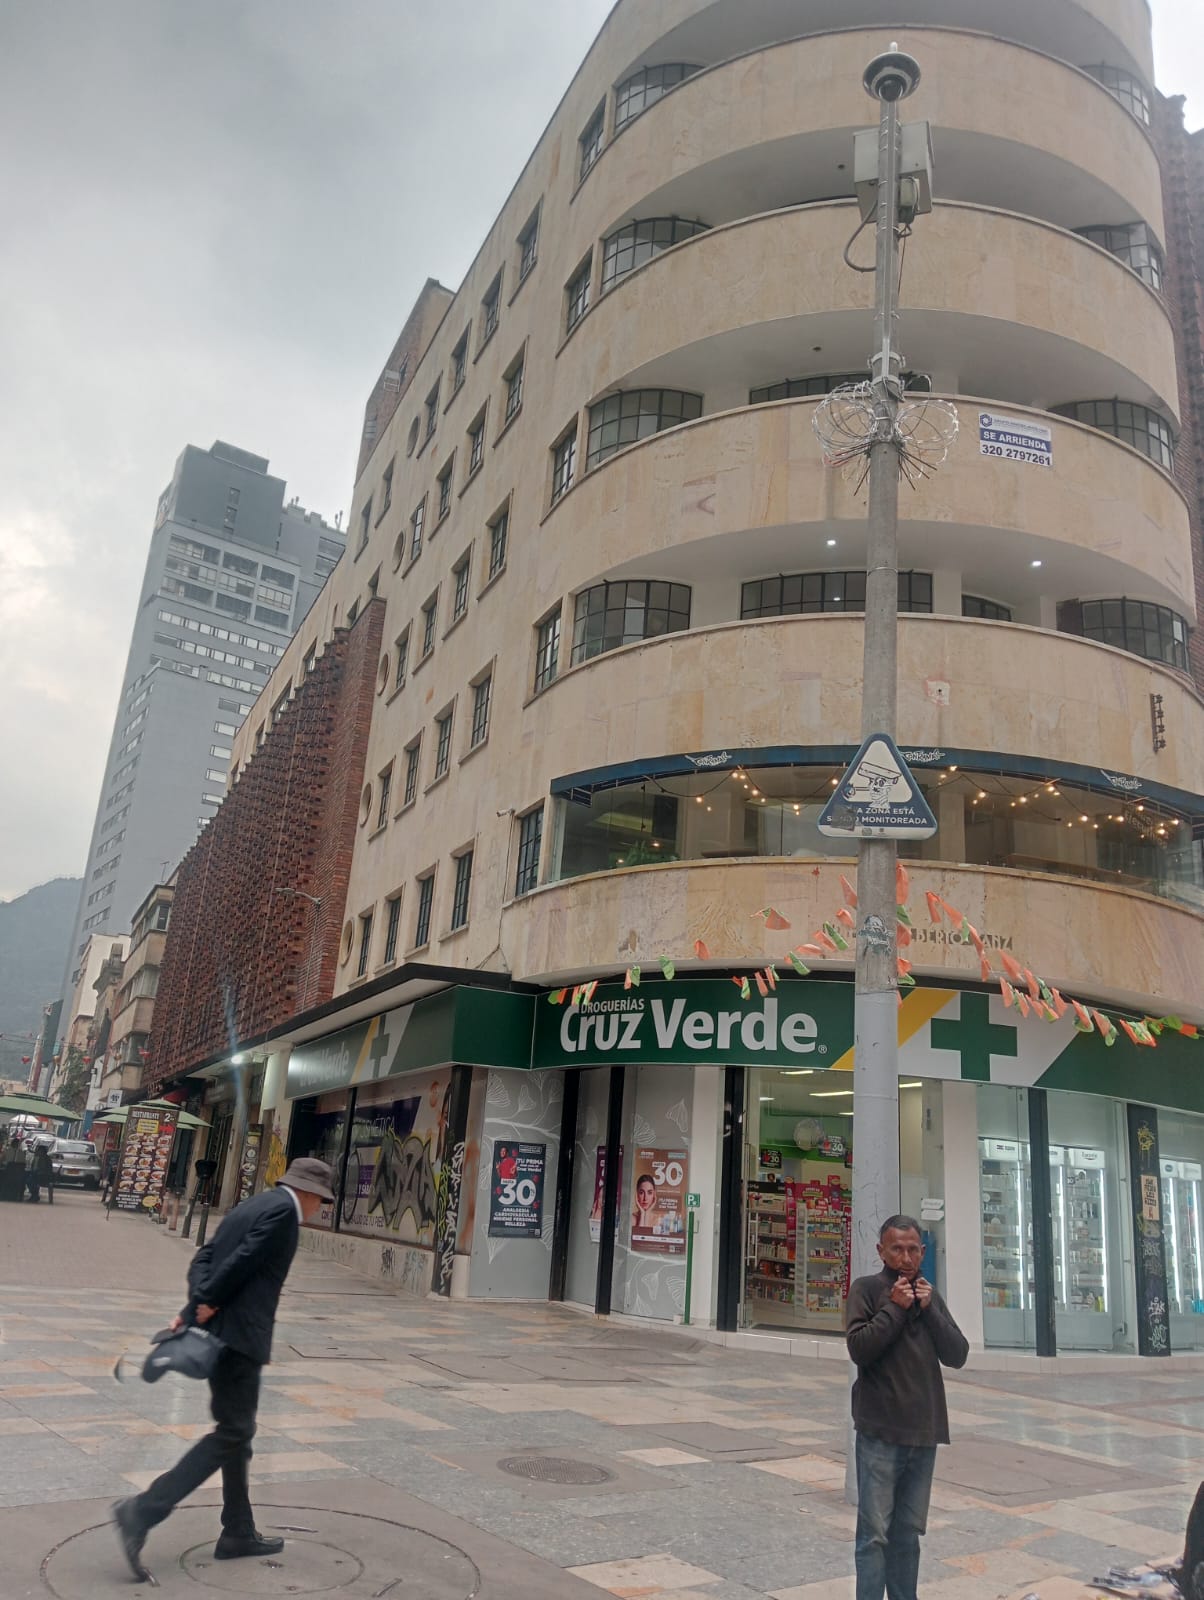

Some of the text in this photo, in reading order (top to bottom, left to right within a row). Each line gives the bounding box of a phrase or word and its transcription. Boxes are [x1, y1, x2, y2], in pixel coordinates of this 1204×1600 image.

[983, 431, 1047, 450] SE ARRIENDA
[982, 444, 1051, 466] 320 2797261
[893, 805, 915, 815] ESTÁ
[862, 816, 927, 825] MONITOREADA
[580, 996, 645, 1013] DROGUERÍAS
[560, 998, 818, 1053] Cruz Verde
